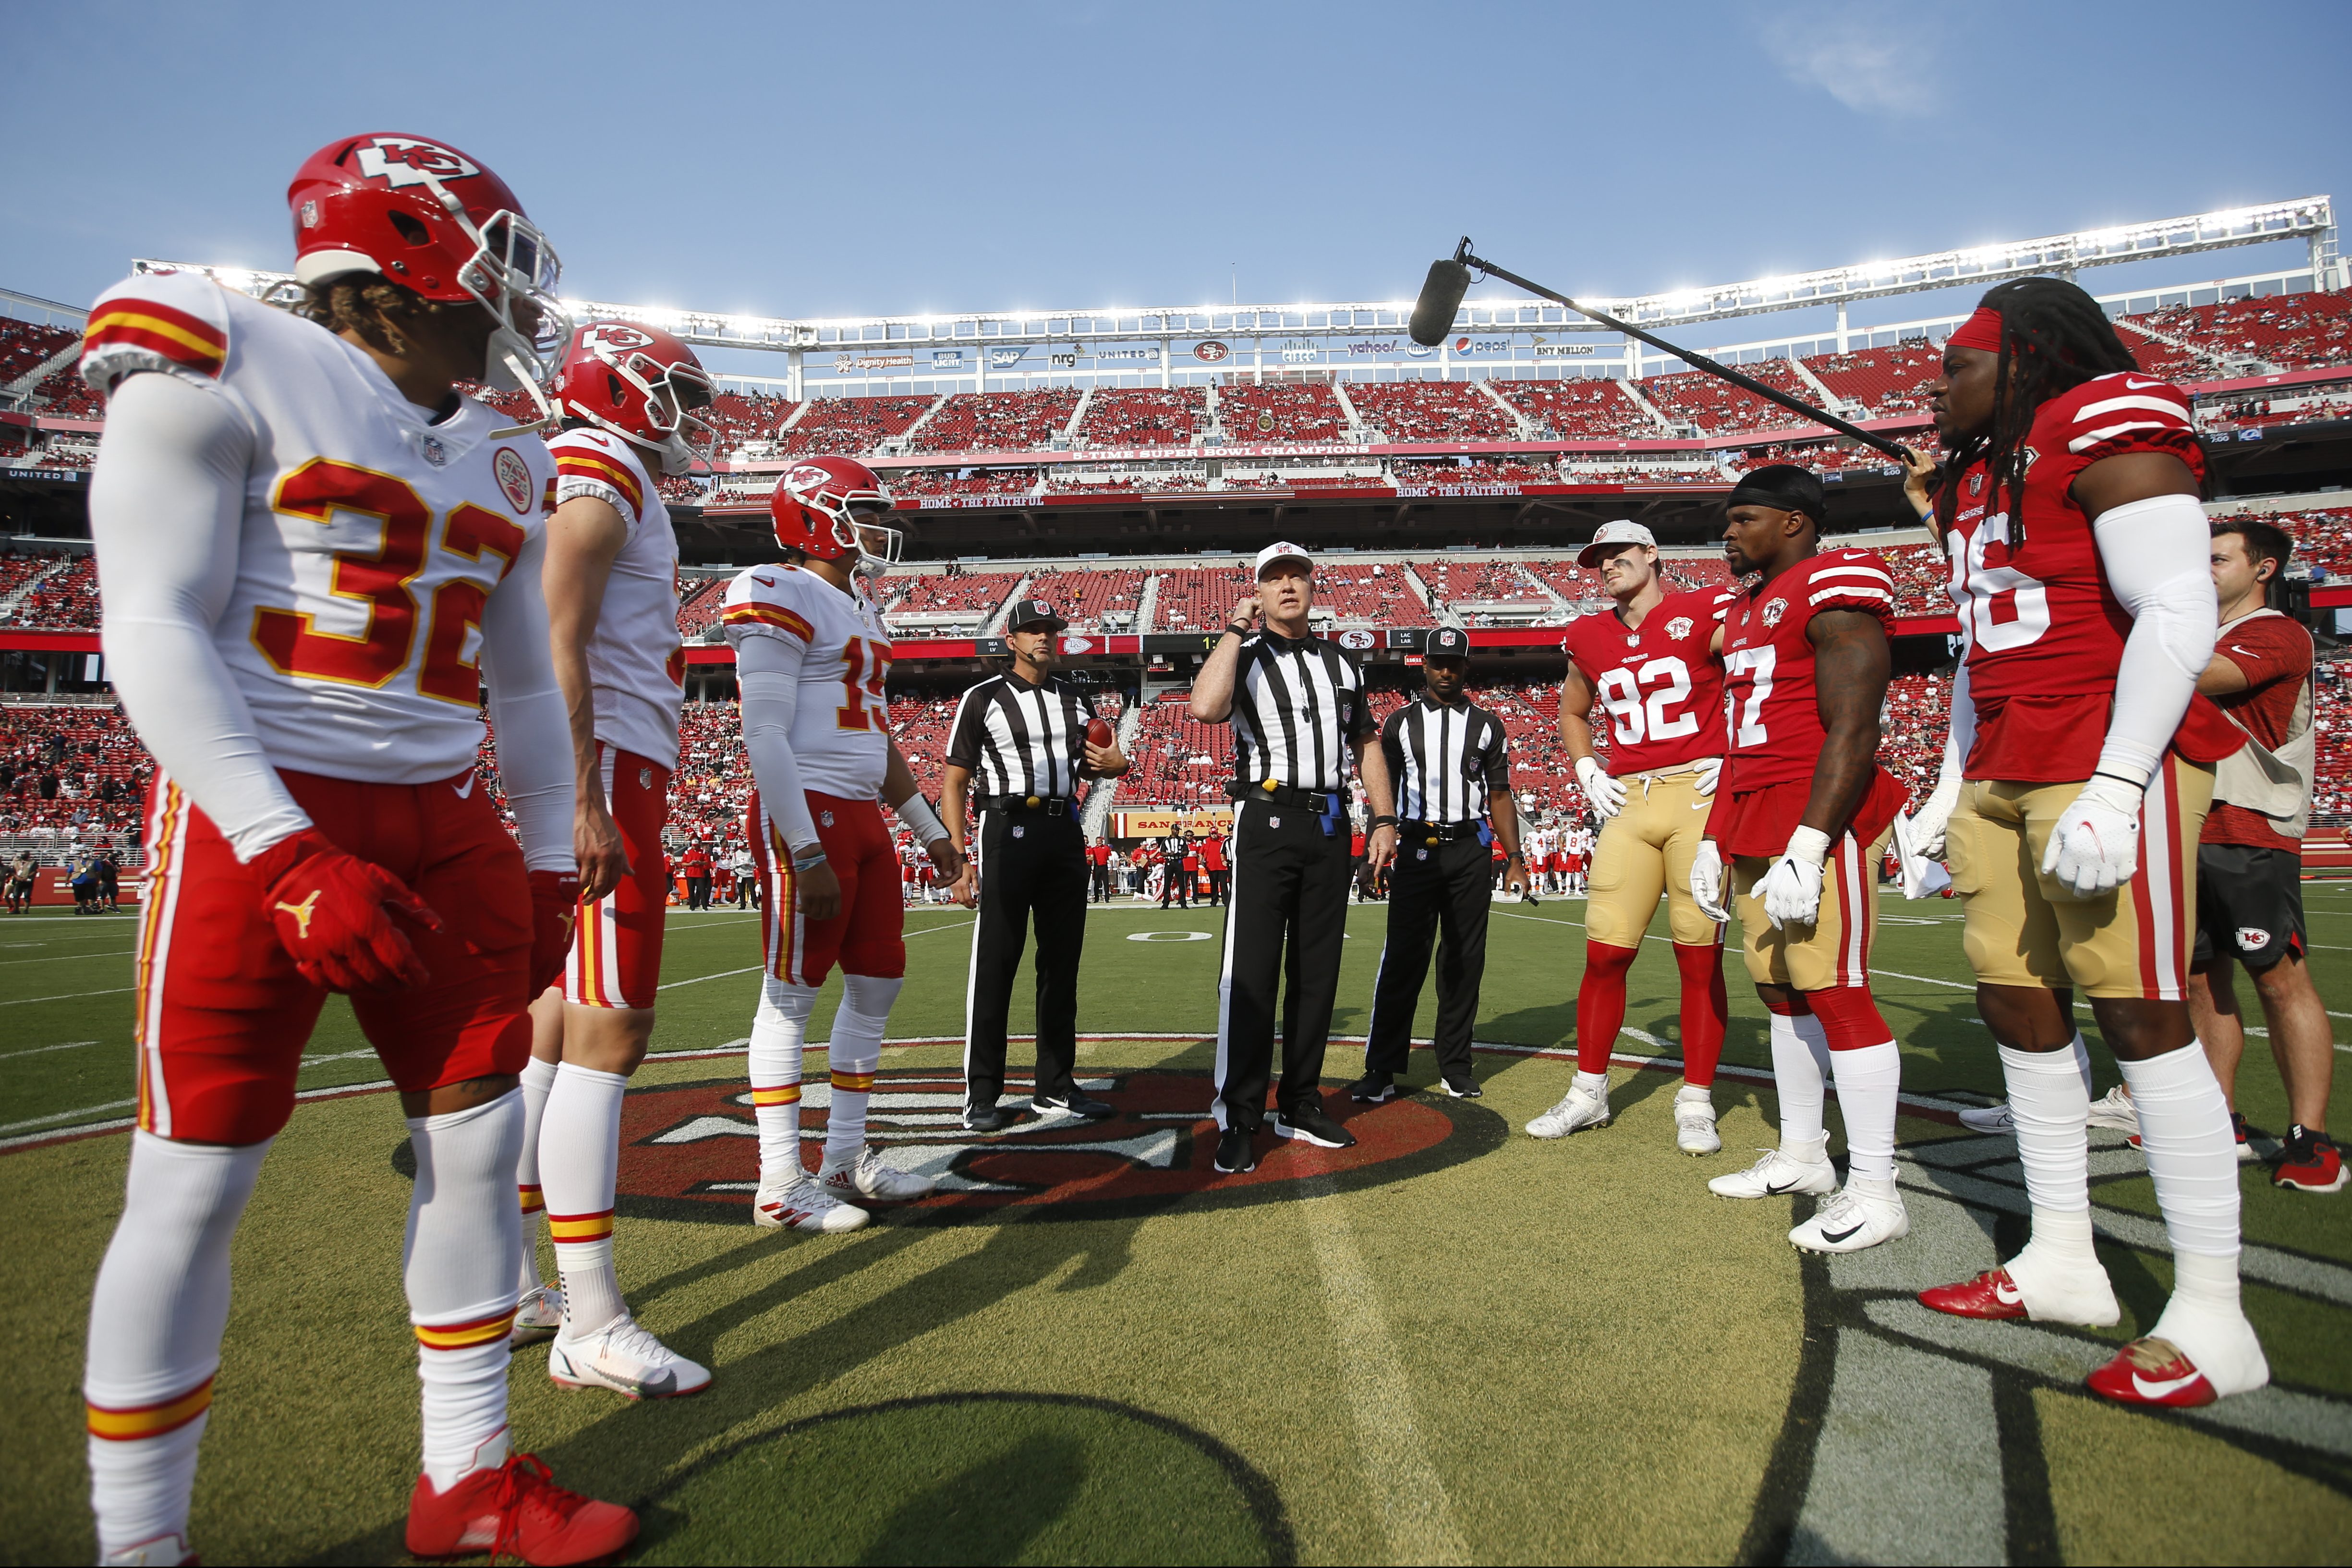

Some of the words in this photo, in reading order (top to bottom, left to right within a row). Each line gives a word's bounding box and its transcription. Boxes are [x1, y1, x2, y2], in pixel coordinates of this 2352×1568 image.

[383, 145, 462, 175] KC
[595, 328, 643, 346] KC
[1202, 344, 1223, 360] SF
[1348, 340, 1397, 356] yahoo!
[1475, 340, 1510, 353] pepsi
[857, 358, 885, 369] Dignity
[886, 356, 911, 365] Health
[992, 352, 1020, 364] SAP
[1052, 353, 1076, 367] nrg
[1073, 450, 1134, 460] 5-TIME
[1140, 449, 1198, 458] SUPER
[1203, 448, 1255, 457] BOWL
[1261, 445, 1370, 455] CHAMPIONS
[9, 471, 61, 479] UNITED
[791, 468, 823, 485] KC
[1395, 487, 1429, 498] HOME
[1437, 486, 1461, 497] THE
[1463, 486, 1522, 496] FAITHFUL
[920, 499, 952, 509] HOME
[961, 498, 983, 508] THE
[985, 496, 1043, 507] FAITHFUL
[1956, 505, 1984, 521] 49ERS
[249, 455, 525, 708] 32
[1767, 602, 1781, 619] 75
[1671, 621, 1686, 634] 75
[1071, 640, 1090, 650] KC
[1203, 637, 1224, 649] 1:
[1349, 633, 1369, 647] SF
[1621, 653, 1649, 663] 49ERS
[837, 635, 893, 735] 15
[1598, 656, 1700, 744] 82
[1538, 838, 1543, 847] 4
[1570, 837, 1577, 847] 8
[2244, 933, 2265, 945] KC
[825, 1179, 853, 1190] adidas
